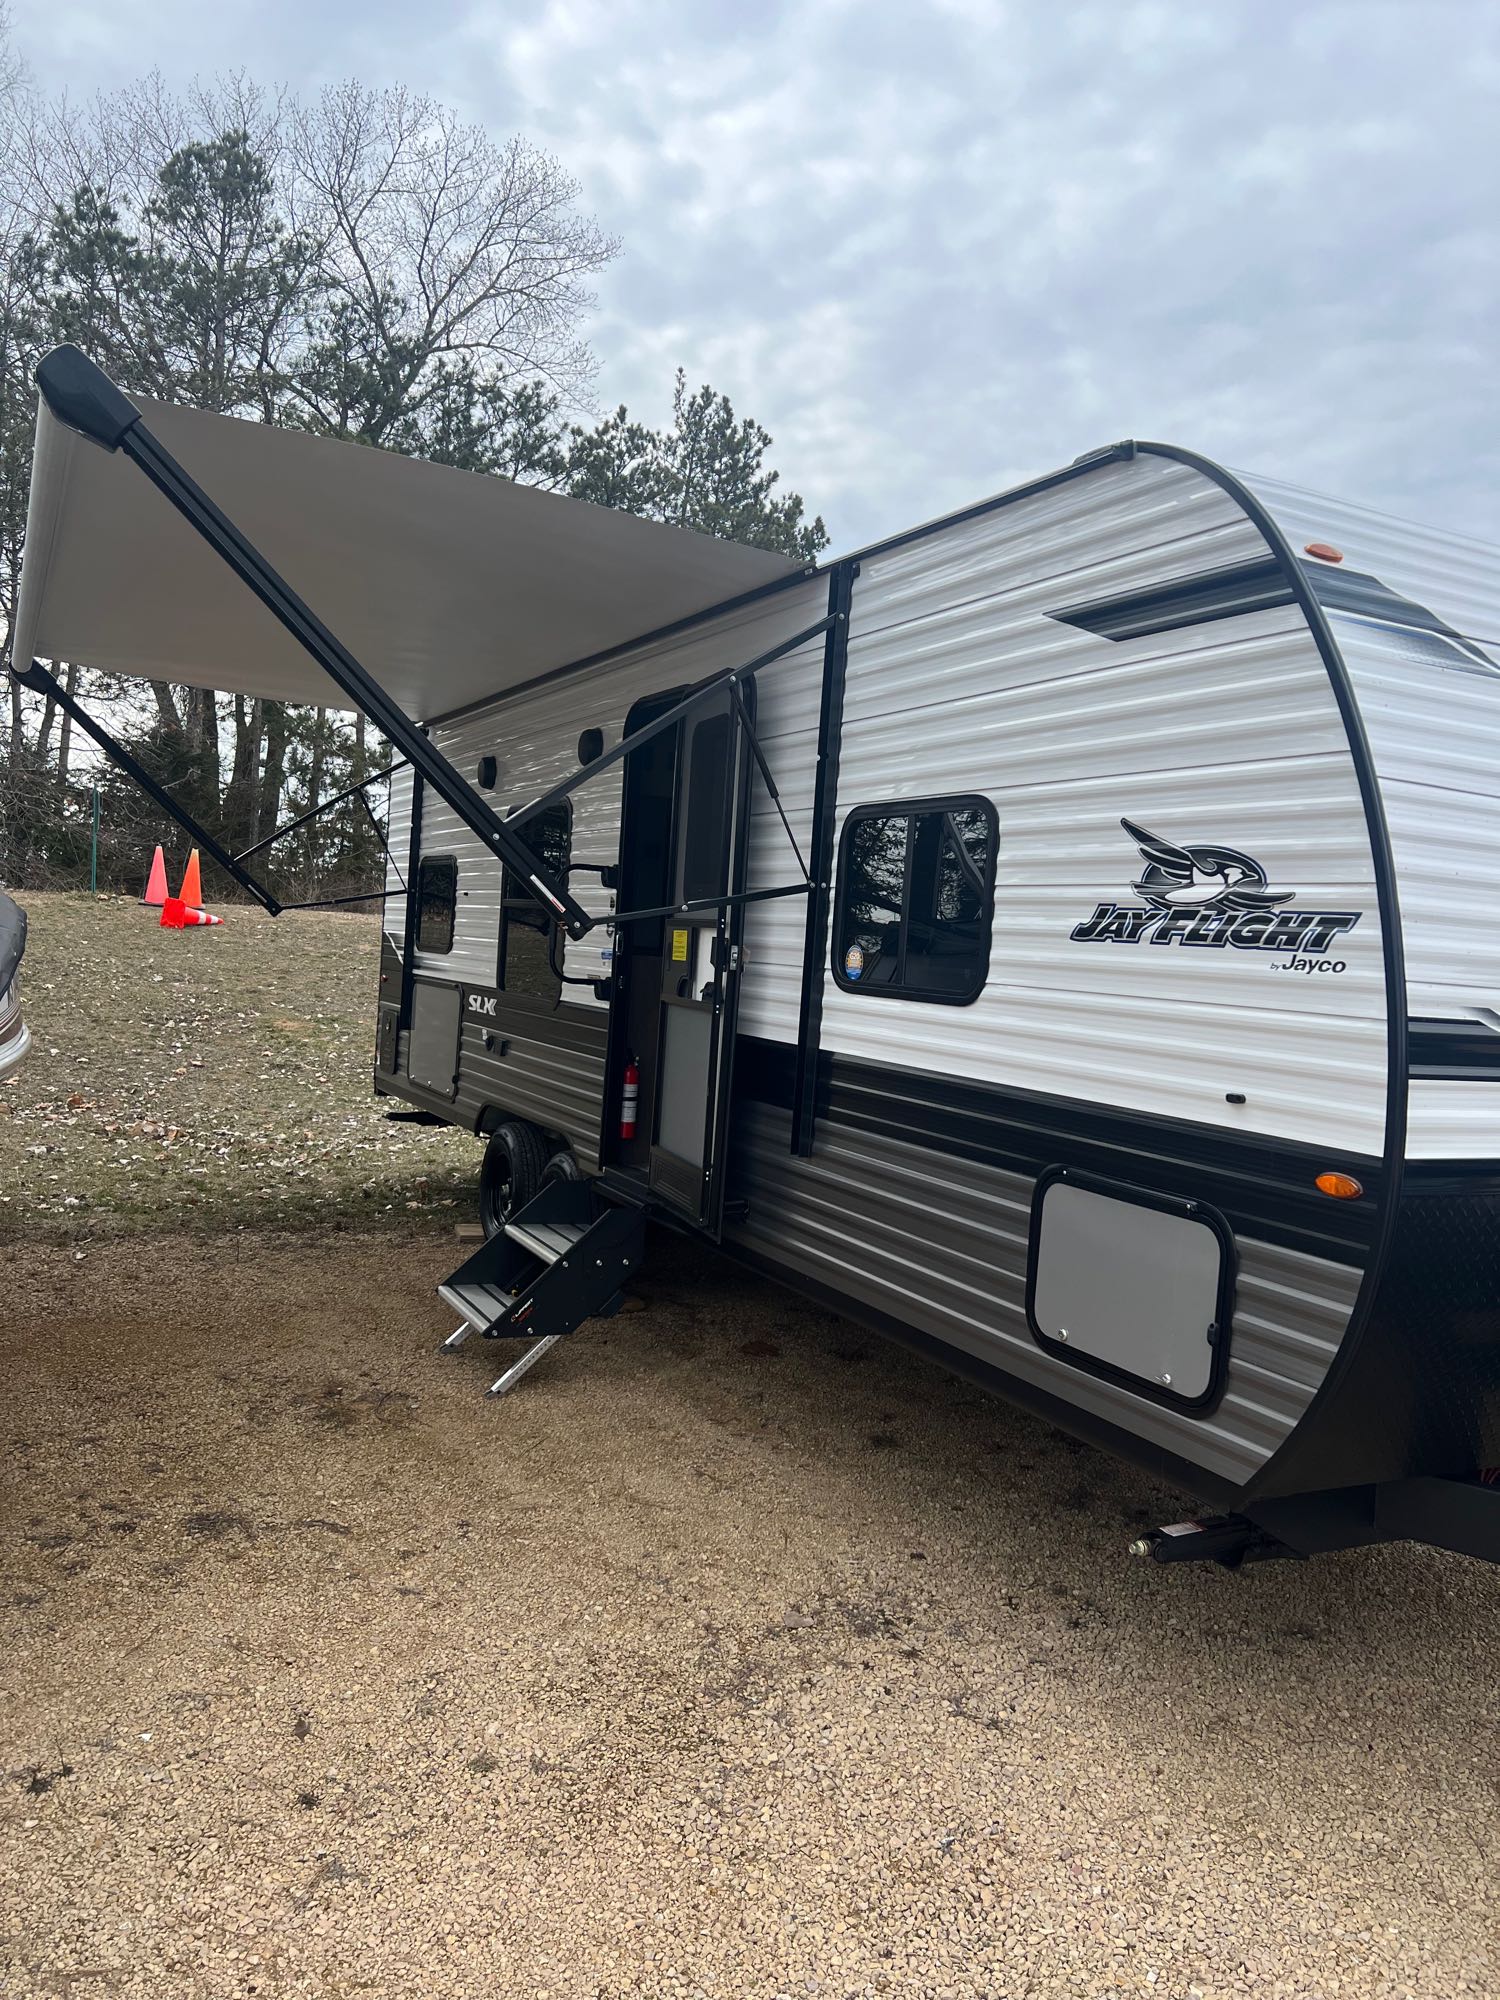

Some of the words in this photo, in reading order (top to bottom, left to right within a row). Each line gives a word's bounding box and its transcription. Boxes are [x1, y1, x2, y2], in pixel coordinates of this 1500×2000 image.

[1270, 962, 1281, 972] by
[1281, 954, 1347, 974] Jayco
[468, 994, 497, 1016] SLK
